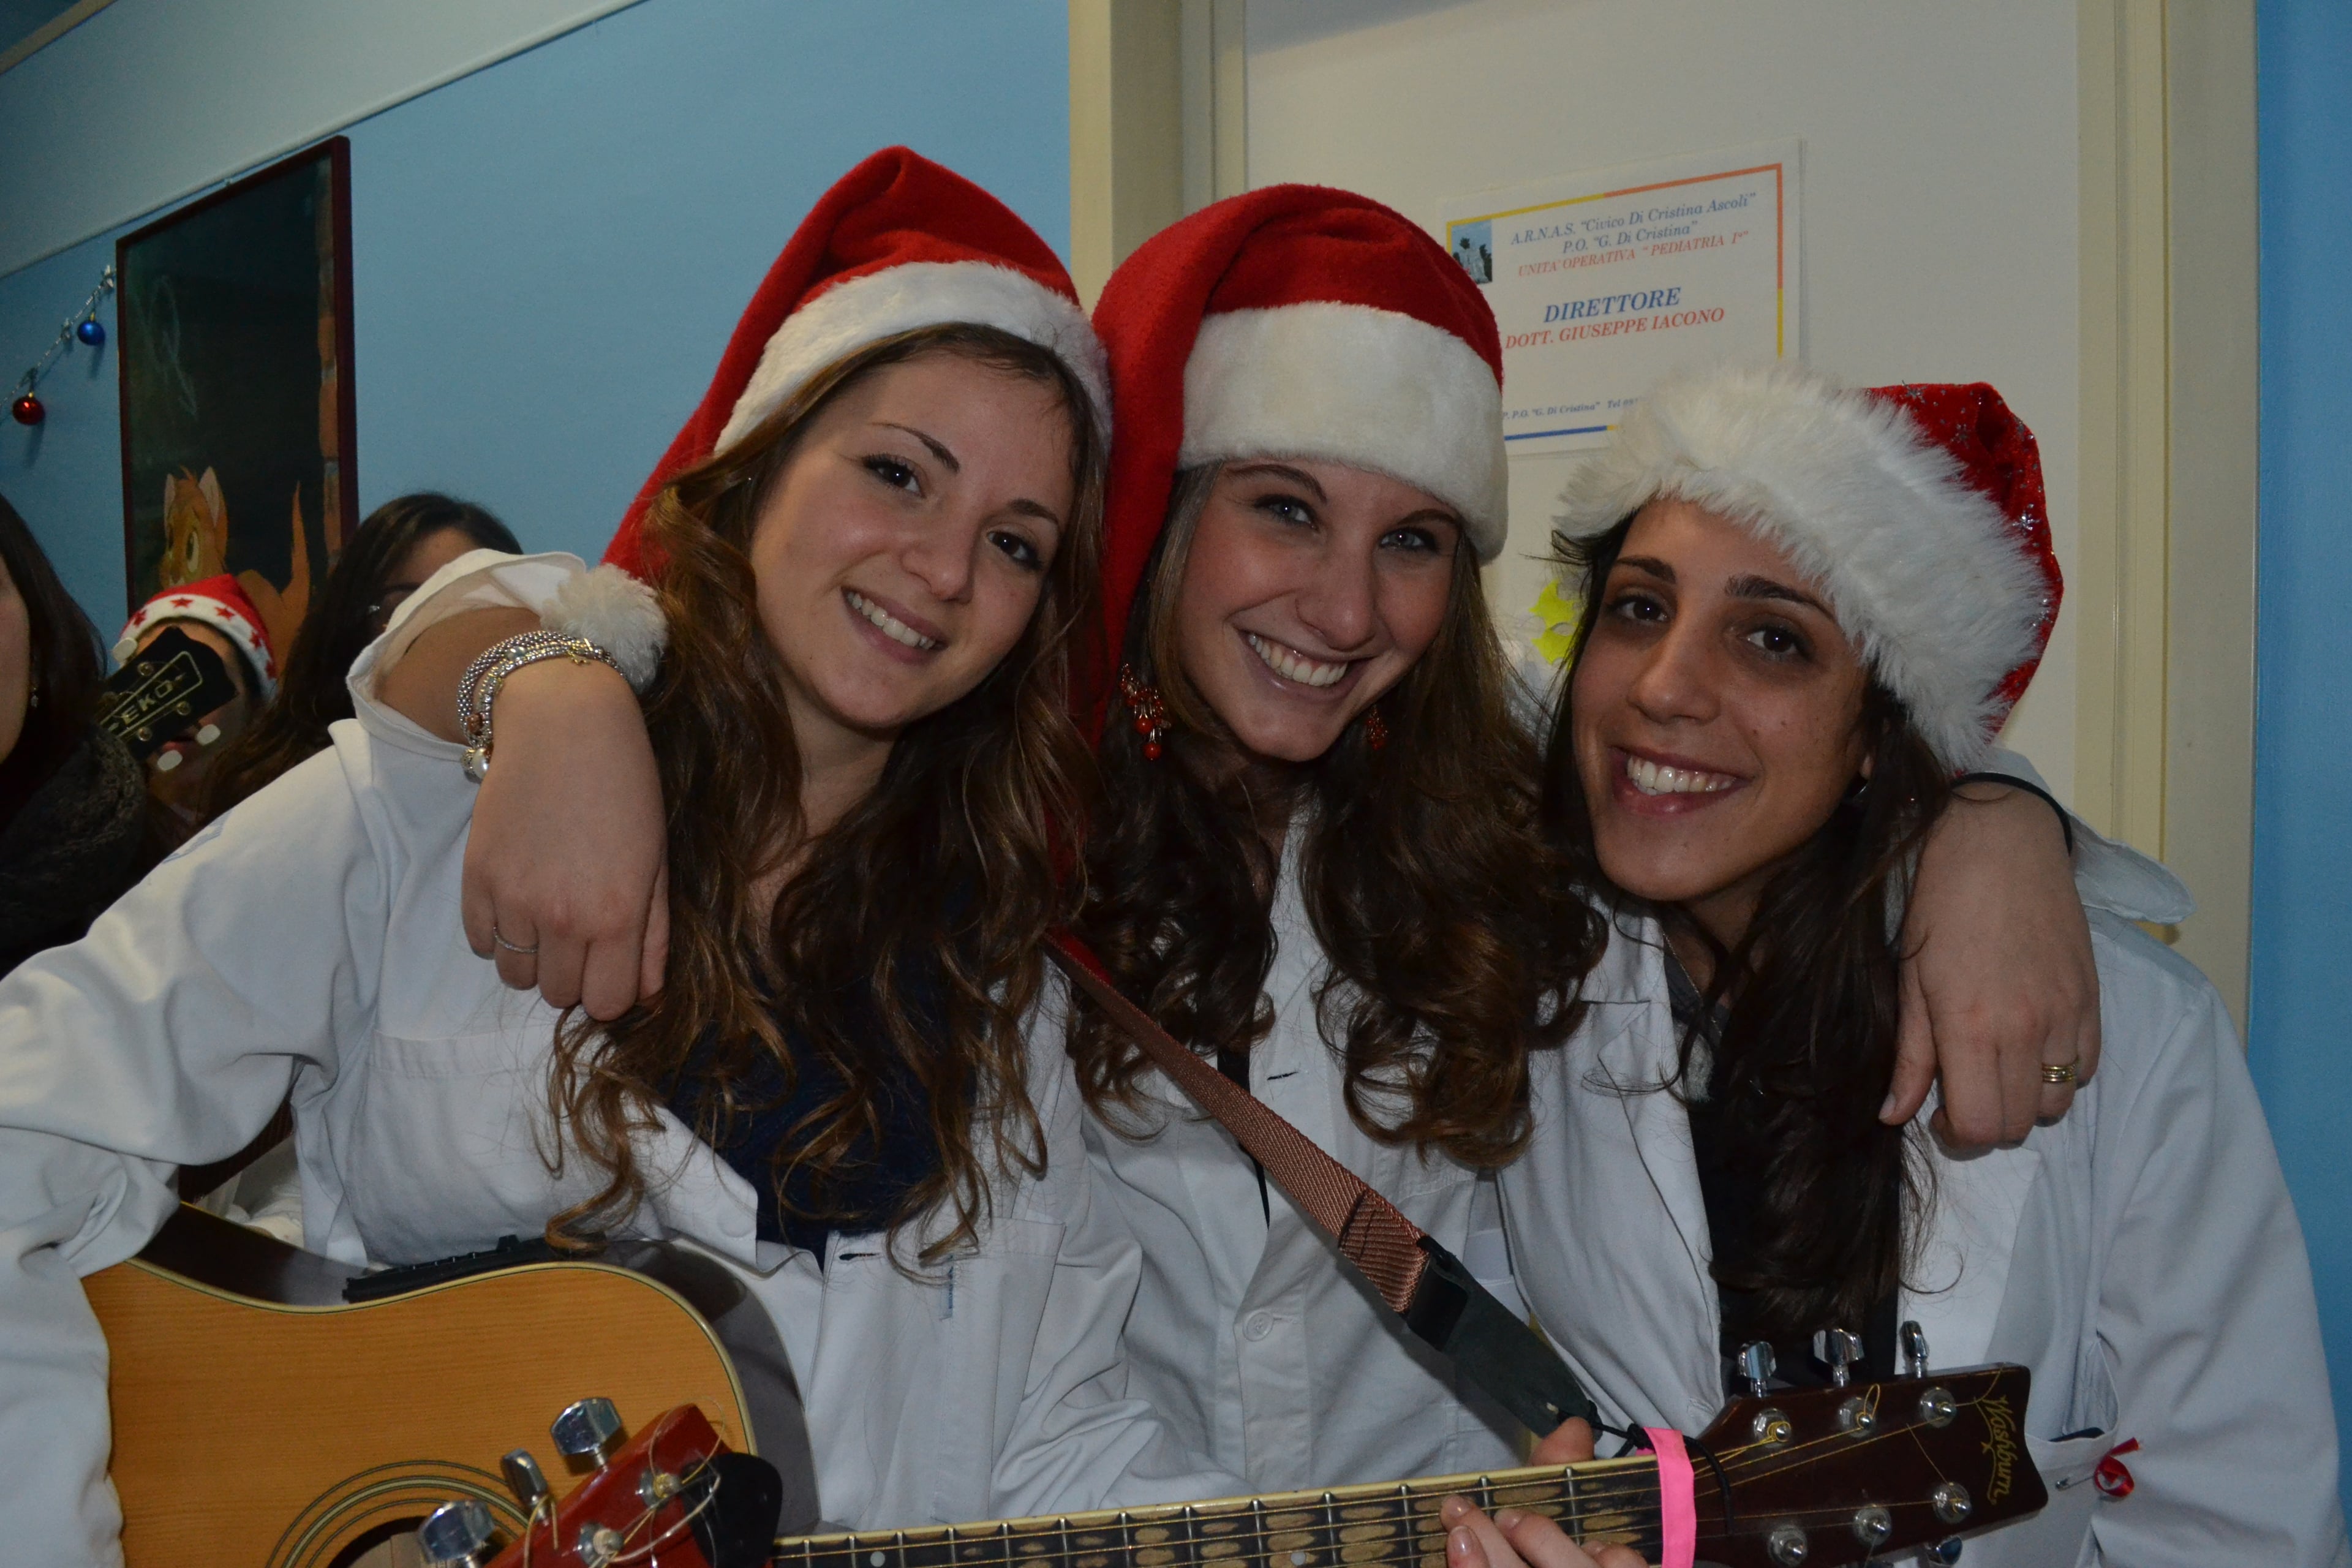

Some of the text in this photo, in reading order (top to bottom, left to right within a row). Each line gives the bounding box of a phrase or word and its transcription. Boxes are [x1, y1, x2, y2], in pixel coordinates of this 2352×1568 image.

[1511, 222, 1575, 245] A.R.N.A.S.
[1629, 211, 1643, 225] Di
[1648, 203, 1702, 221] Cristina
[1562, 238, 1588, 254] P.O.
[1617, 230, 1632, 245] Di
[1562, 249, 1635, 269] OPERATIVA
[1651, 235, 1725, 256] PEDIATRIA
[1543, 287, 1681, 323] DIRETTORE
[1505, 307, 1725, 349] DOTT. GIUSEPPE IACONO
[1547, 404, 1556, 415] Di
[1607, 399, 1621, 409] Tel
[123, 679, 173, 725] EKO
[1981, 1394, 2019, 1499] Washburn
